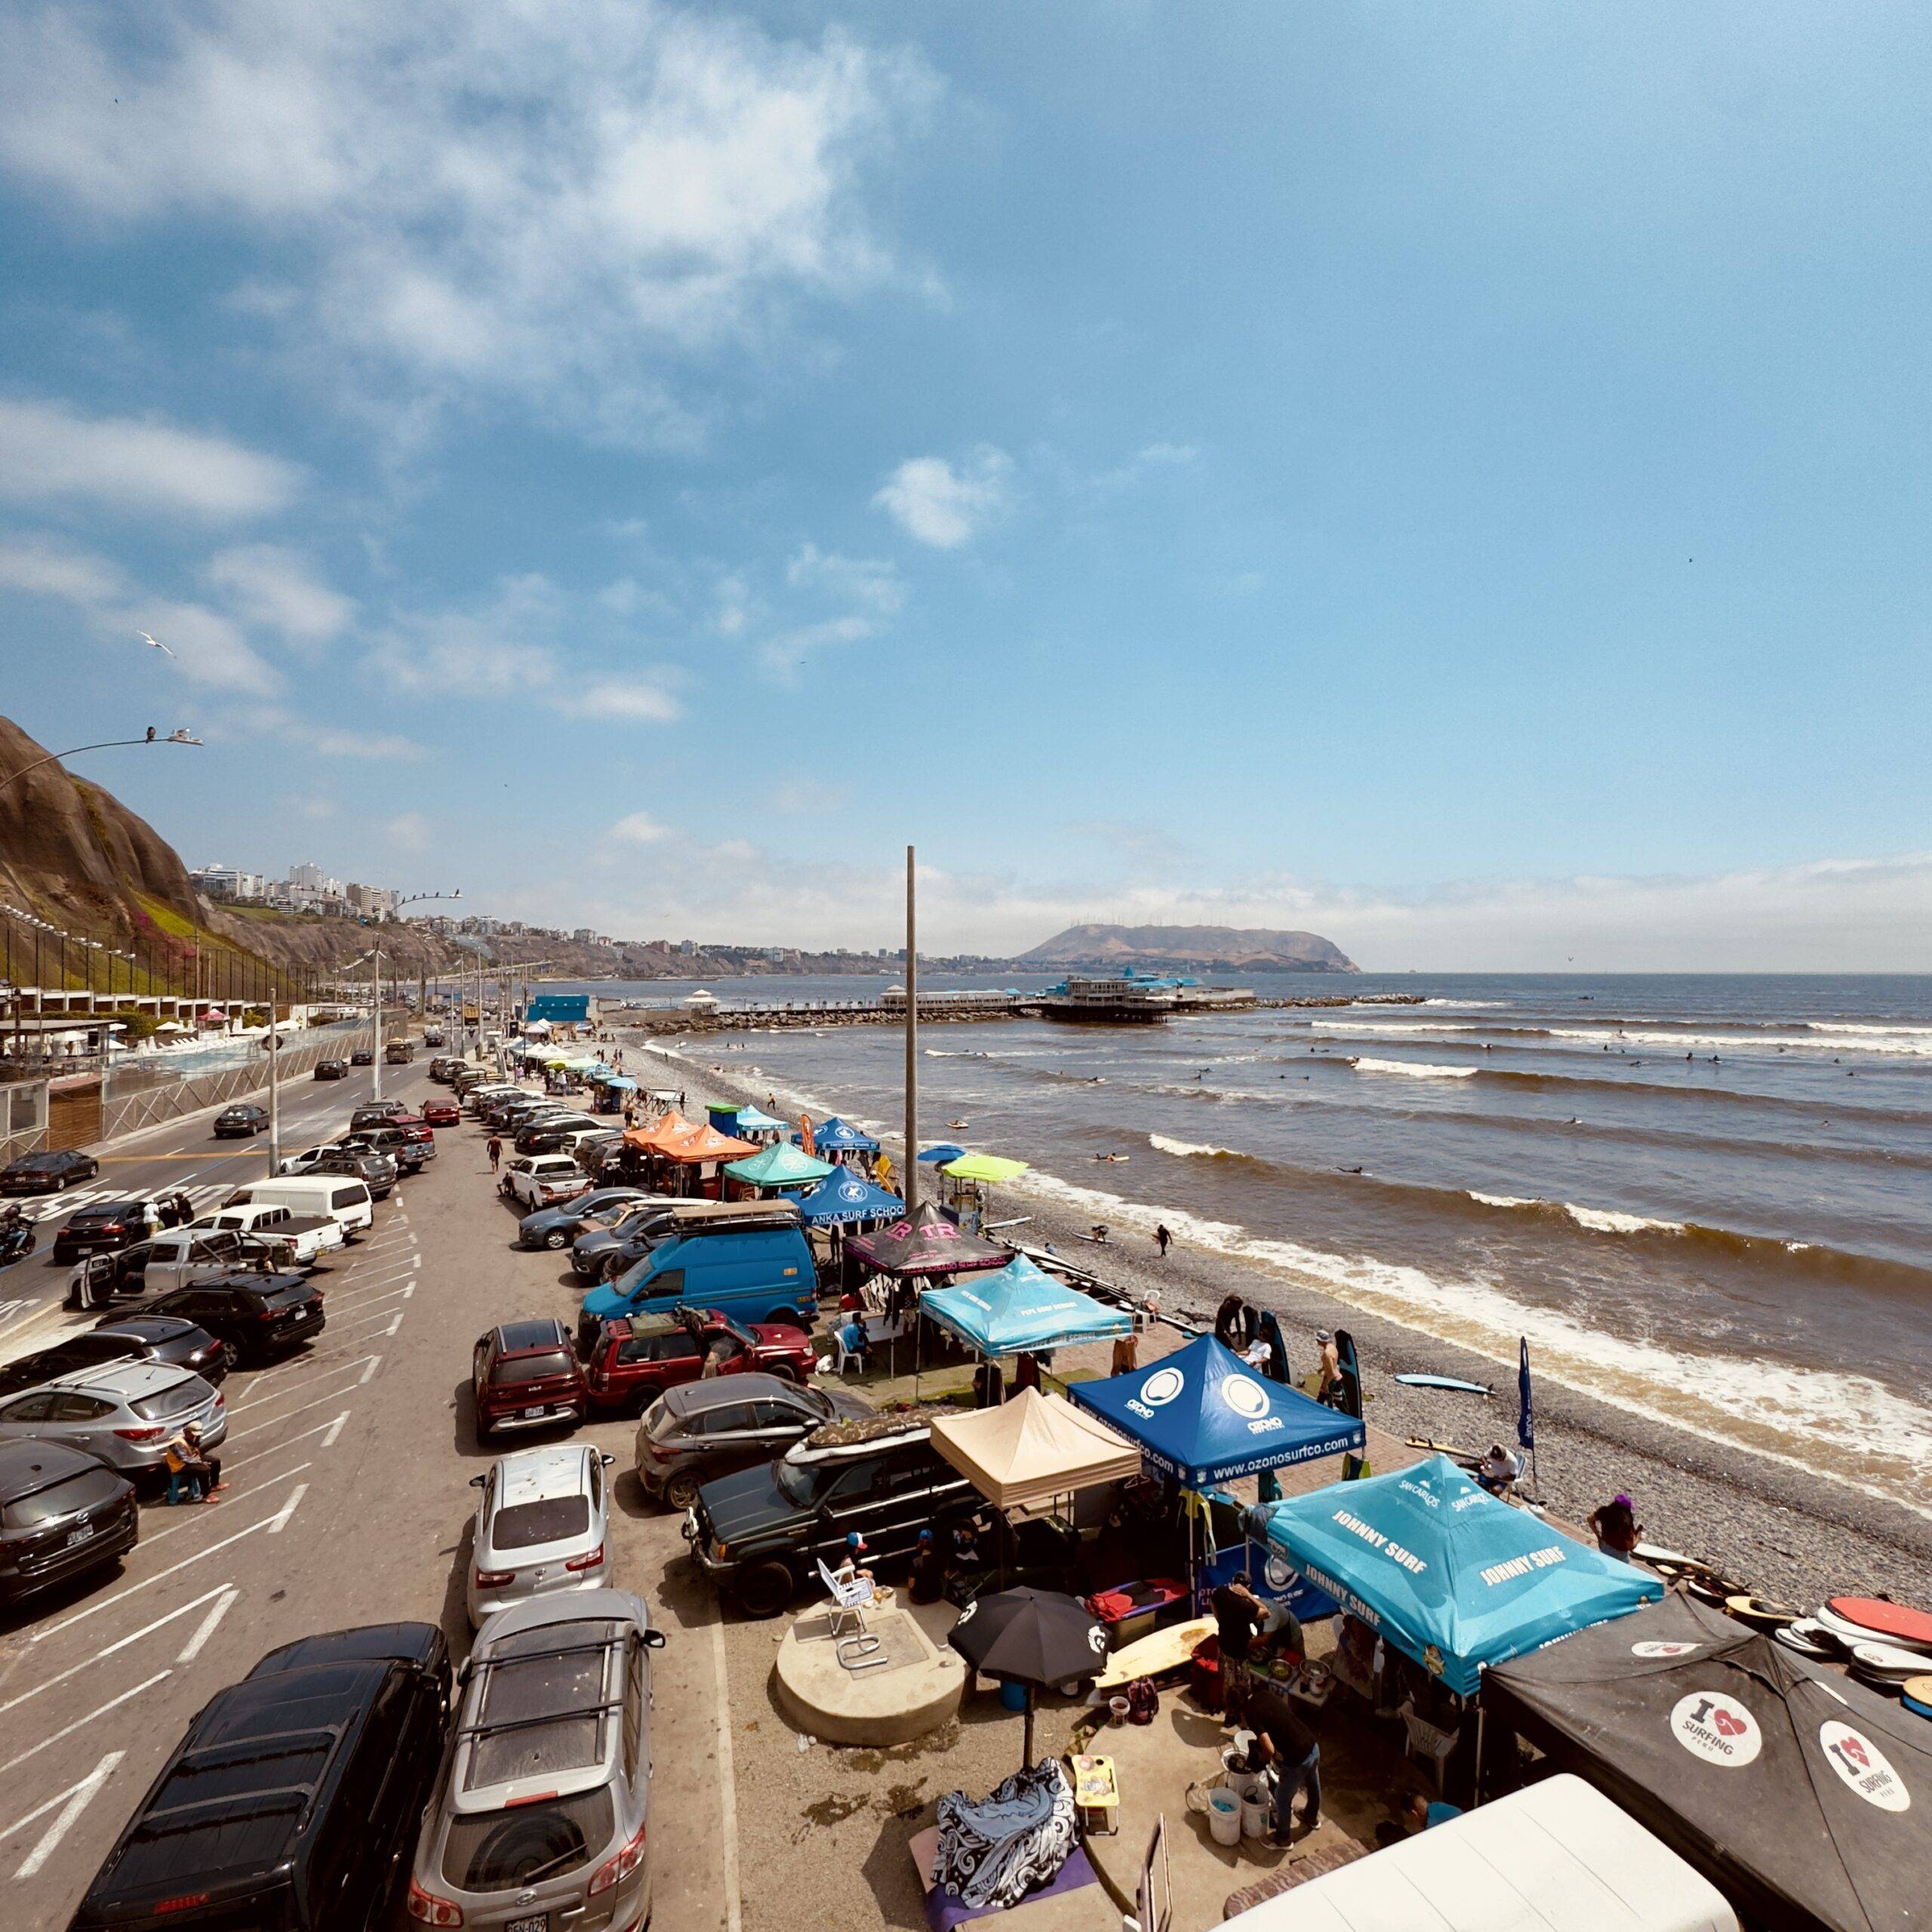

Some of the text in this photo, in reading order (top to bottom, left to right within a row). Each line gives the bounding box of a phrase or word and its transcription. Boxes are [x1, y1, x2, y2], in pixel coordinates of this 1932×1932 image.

[811, 1214, 840, 1225] ANKA
[841, 1210, 868, 1221] SURF
[918, 1223, 957, 1238] TR
[1127, 1398, 1155, 1418] OZONO
[1247, 1417, 1282, 1432] OZONO
[1214, 1437, 1349, 1480] www.ozonosurfco.com
[1412, 1486, 1441, 1509] CARLOS
[1332, 1509, 1428, 1574] JOHNNY SURF
[1480, 1546, 1567, 1587] JOHNNY SURF
[1306, 1564, 1382, 1627] JOHNNY SURF
[1690, 1698, 1715, 1724] I
[1682, 1720, 1734, 1755] SURFING
[1828, 1743, 1861, 1777] I
[1859, 1770, 1893, 1794] SURFING
